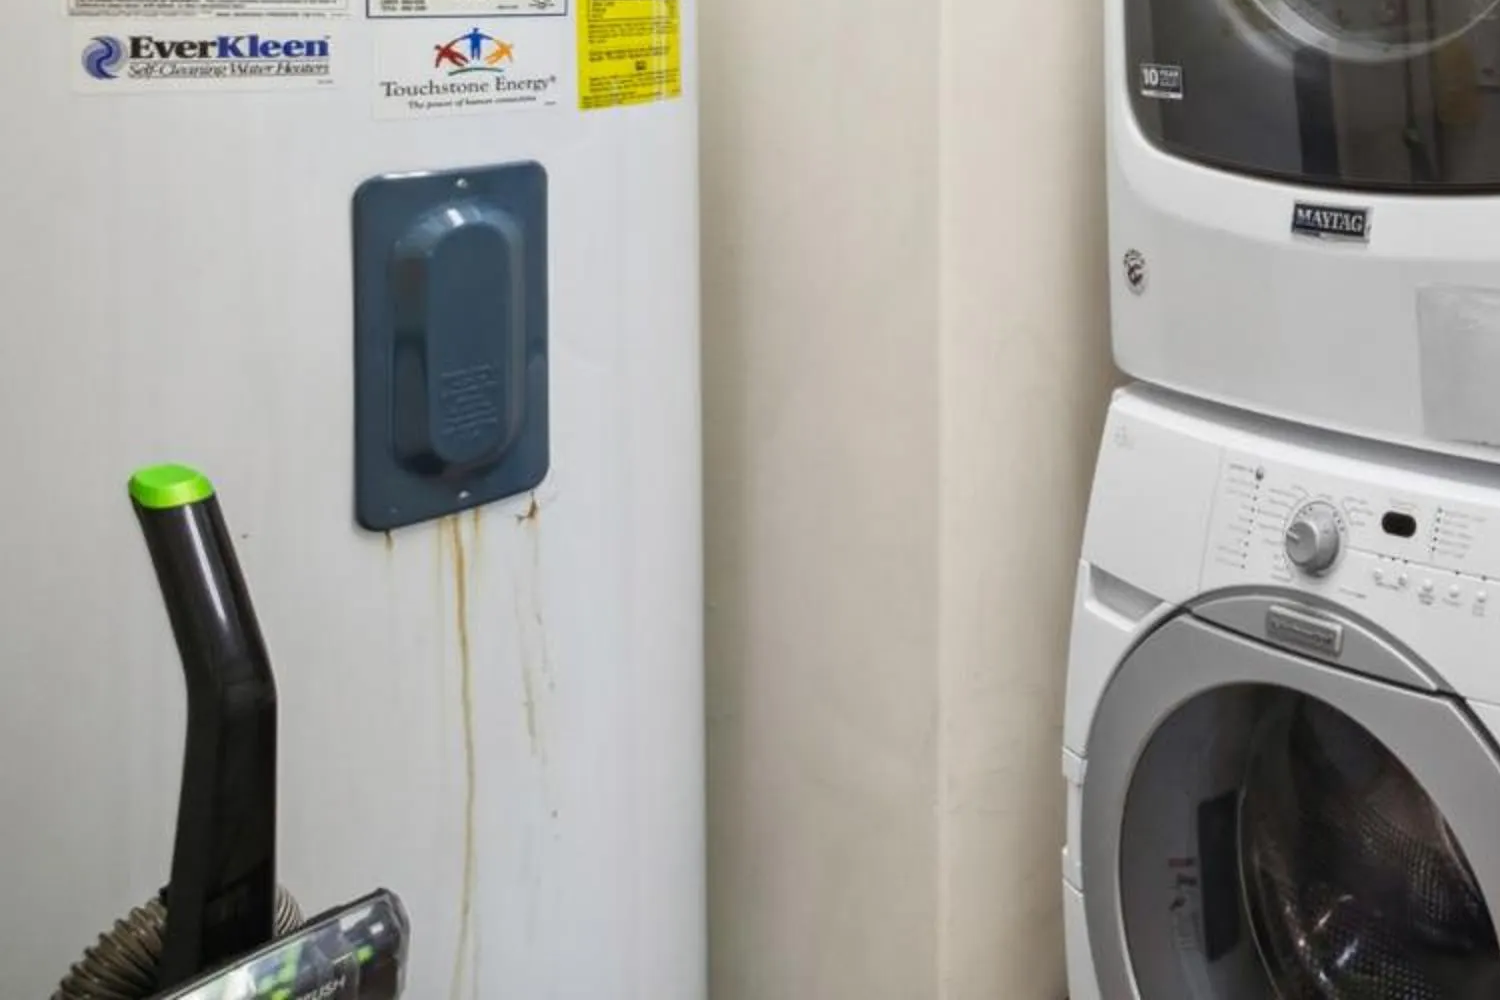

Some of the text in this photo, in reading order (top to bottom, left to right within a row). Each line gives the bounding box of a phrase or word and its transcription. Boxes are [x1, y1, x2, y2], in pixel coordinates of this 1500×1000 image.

[127, 34, 330, 59] EverKleen
[127, 59, 330, 79] Self-Cleaning Water Heaters
[1142, 68, 1159, 86] 10
[379, 79, 489, 97] Touchstone
[1296, 207, 1363, 233] MAYTAG
